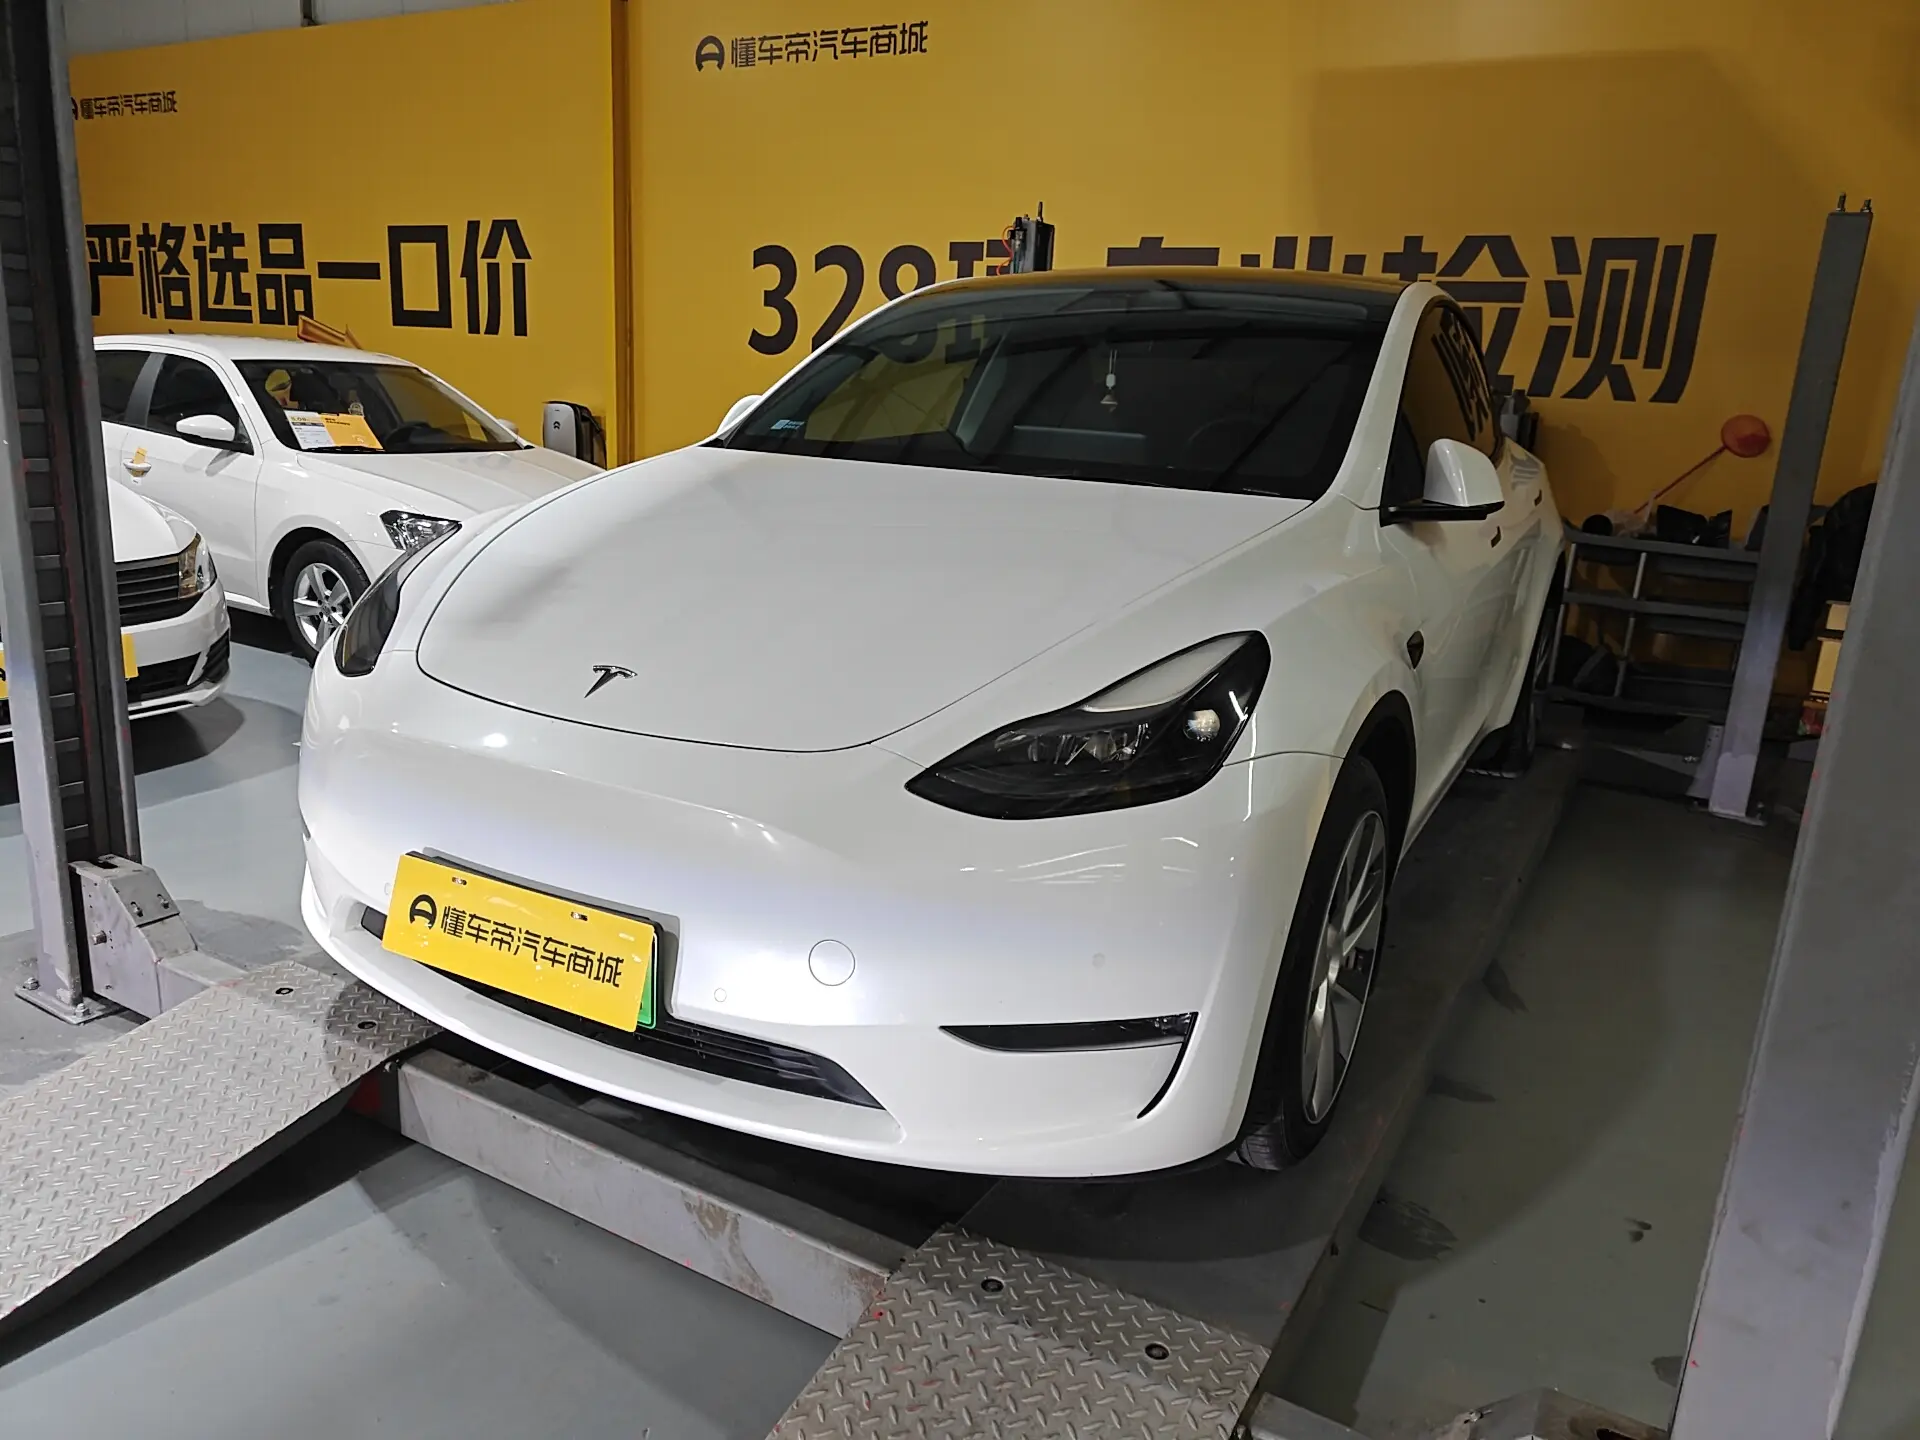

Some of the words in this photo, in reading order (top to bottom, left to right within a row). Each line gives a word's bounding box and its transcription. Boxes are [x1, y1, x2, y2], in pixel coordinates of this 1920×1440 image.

[730, 21, 928, 68] 懂车帝汽车商城
[85, 219, 532, 337] 严格选品一口价
[441, 905, 624, 987] 懂车帝汽车商城
